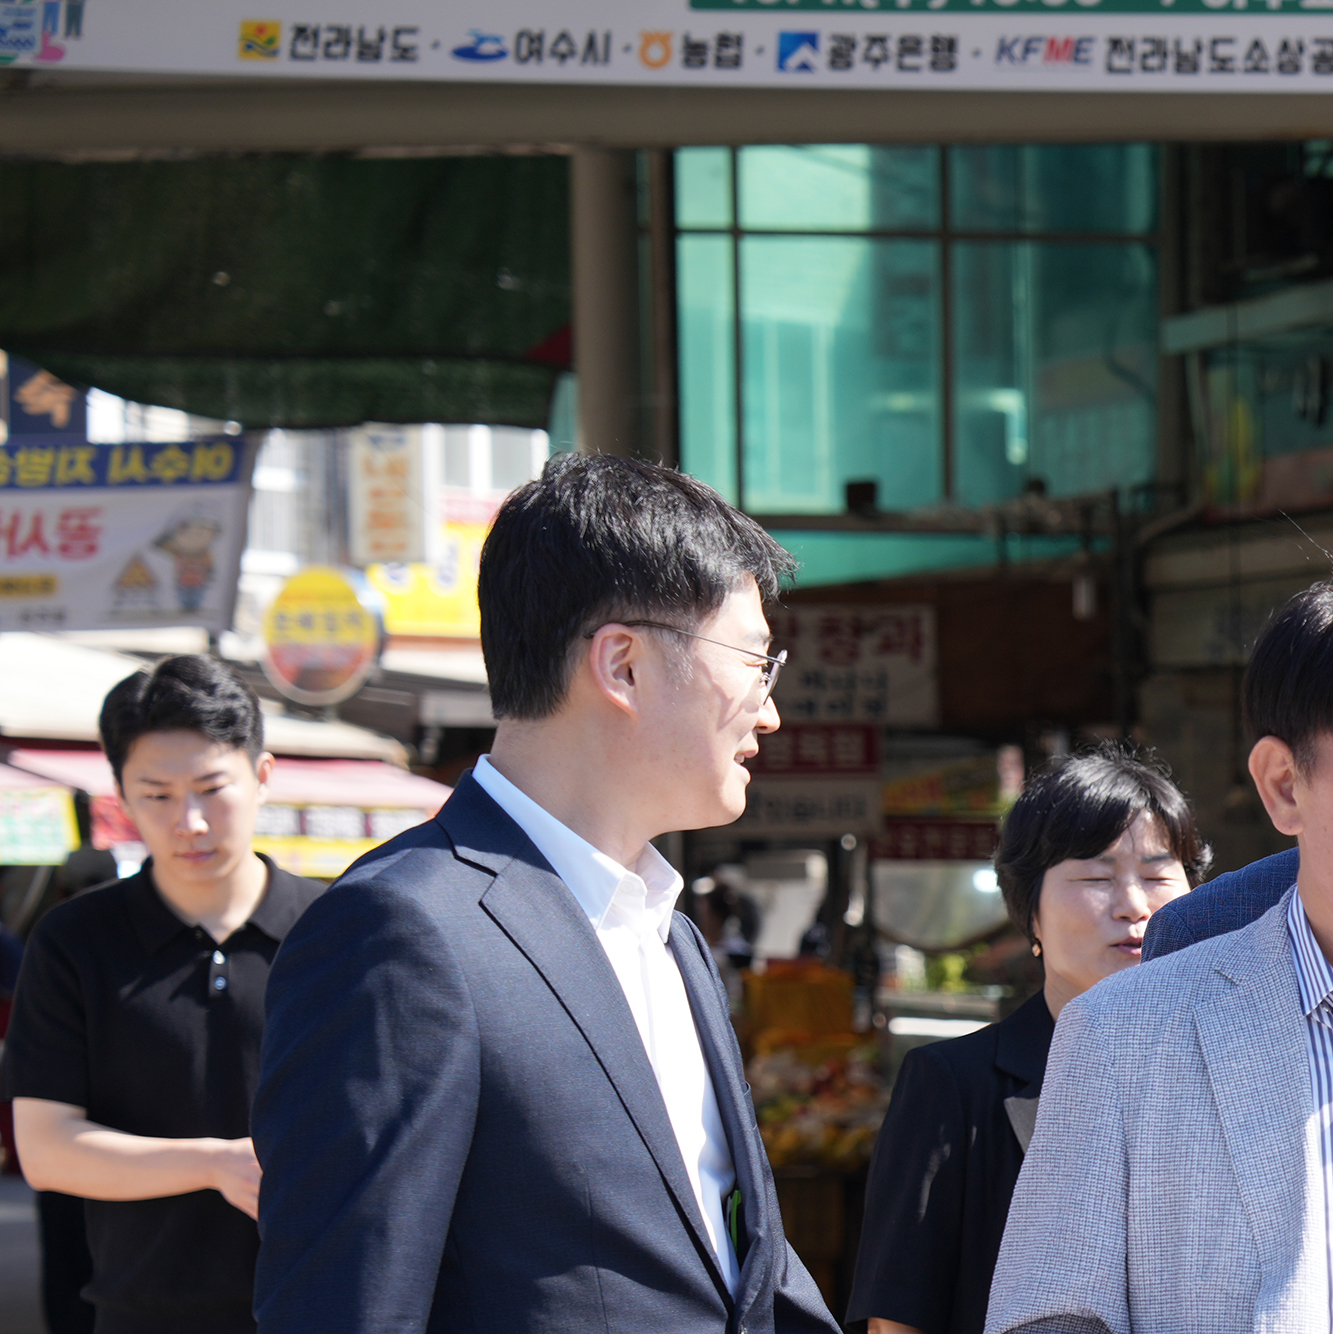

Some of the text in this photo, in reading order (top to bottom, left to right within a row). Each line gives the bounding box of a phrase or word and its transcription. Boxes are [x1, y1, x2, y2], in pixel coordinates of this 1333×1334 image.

[287, 22, 420, 64] 전라남도
[513, 29, 612, 66] 여수시
[680, 31, 745, 70] 농협
[826, 32, 959, 73] 광주은행
[993, 34, 1094, 66] KFME
